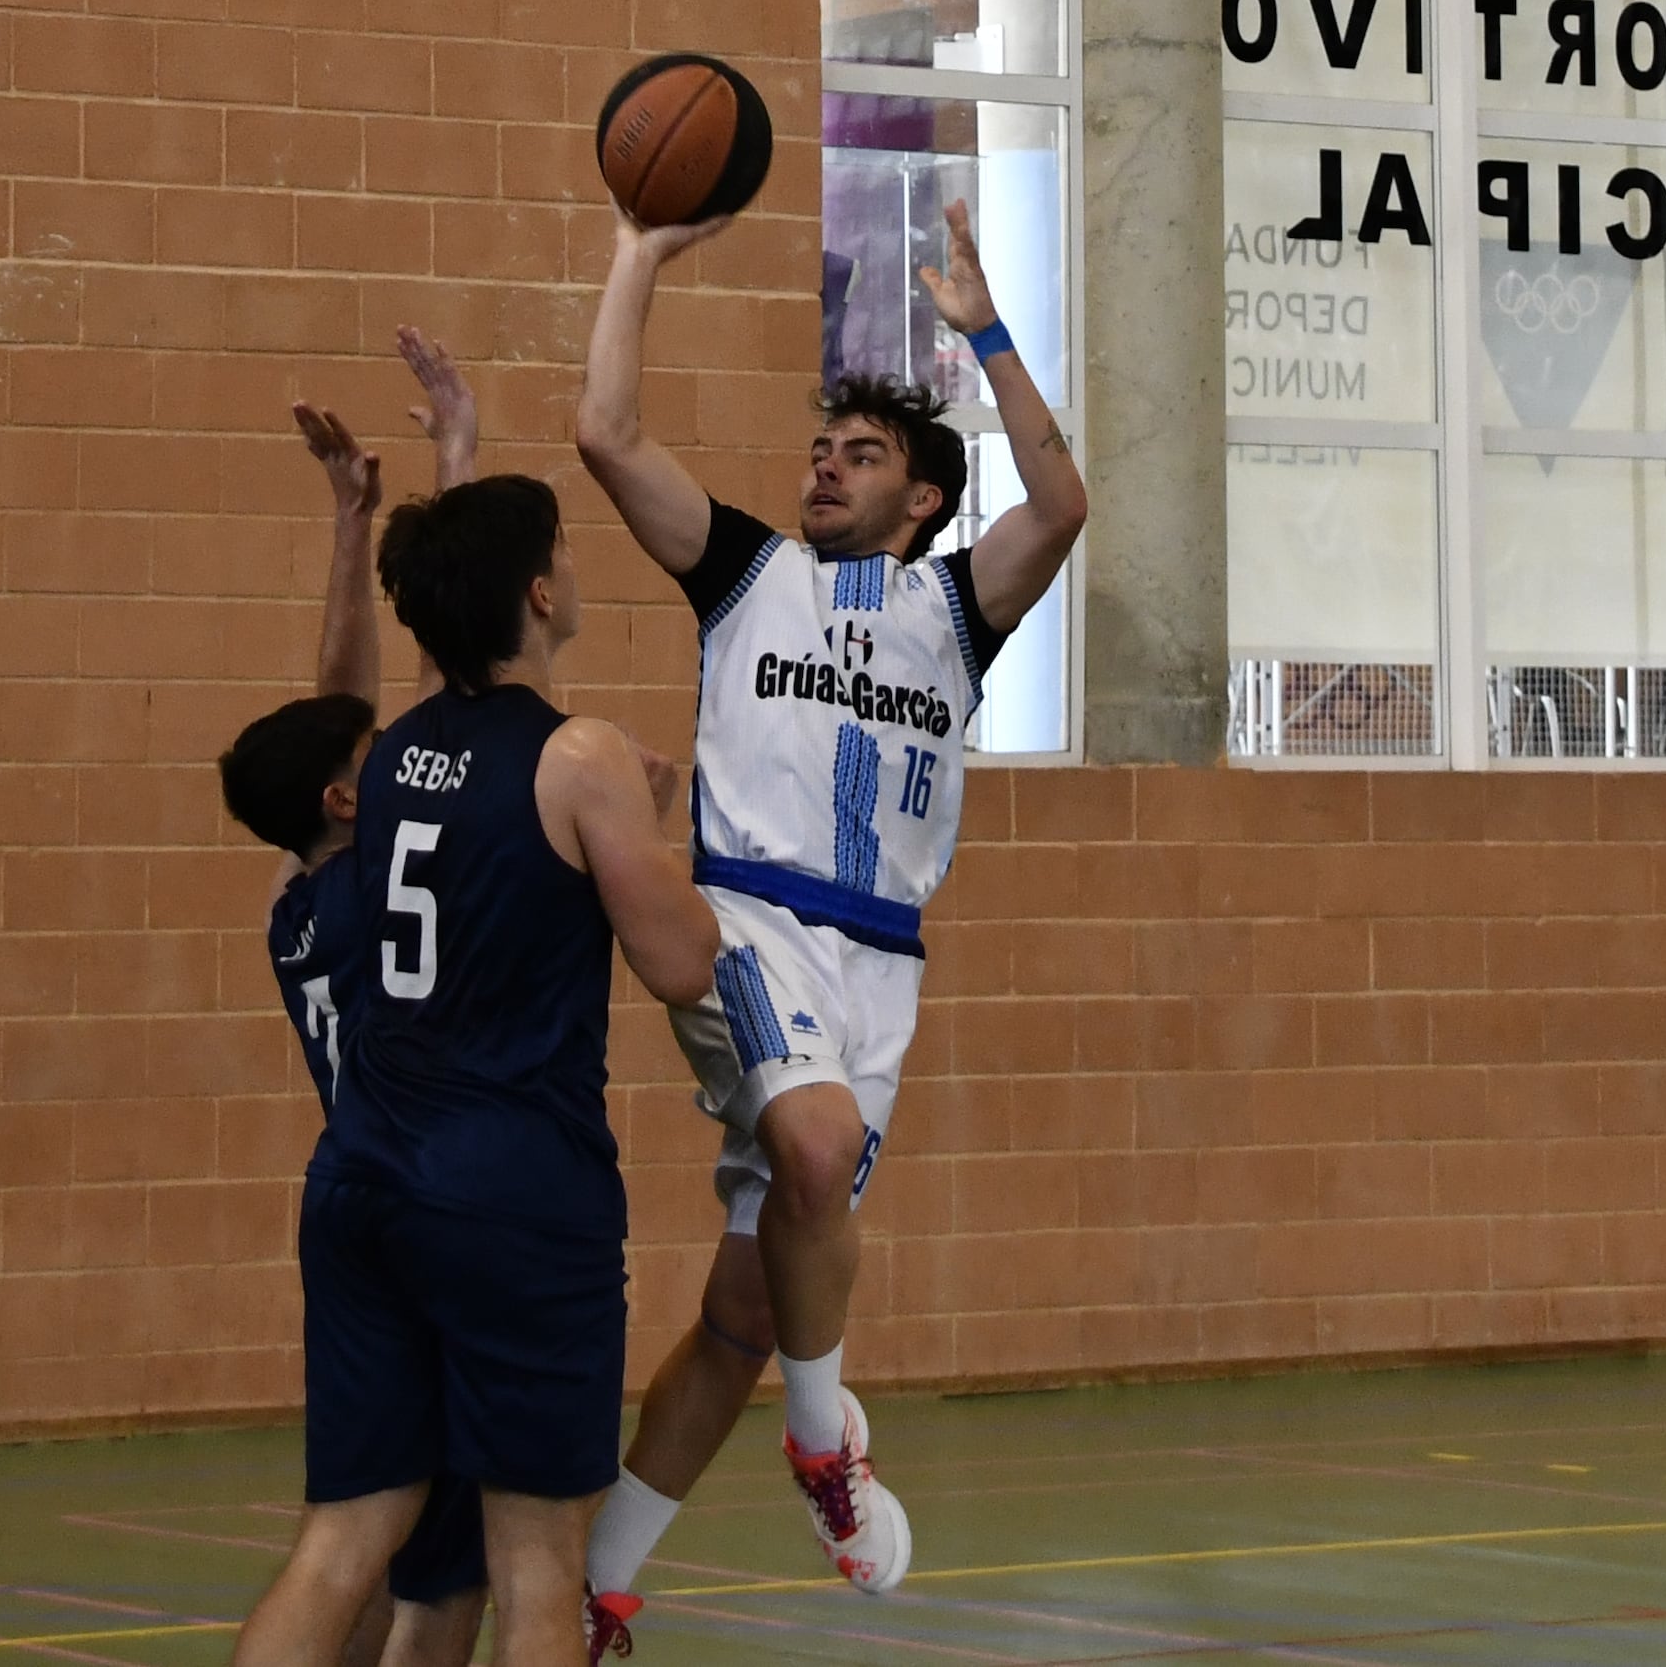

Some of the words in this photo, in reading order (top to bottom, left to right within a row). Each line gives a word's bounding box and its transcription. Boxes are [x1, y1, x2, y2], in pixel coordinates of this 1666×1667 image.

[395, 745, 473, 792] SEBAS
[899, 744, 937, 820] 16
[381, 819, 443, 999] 5
